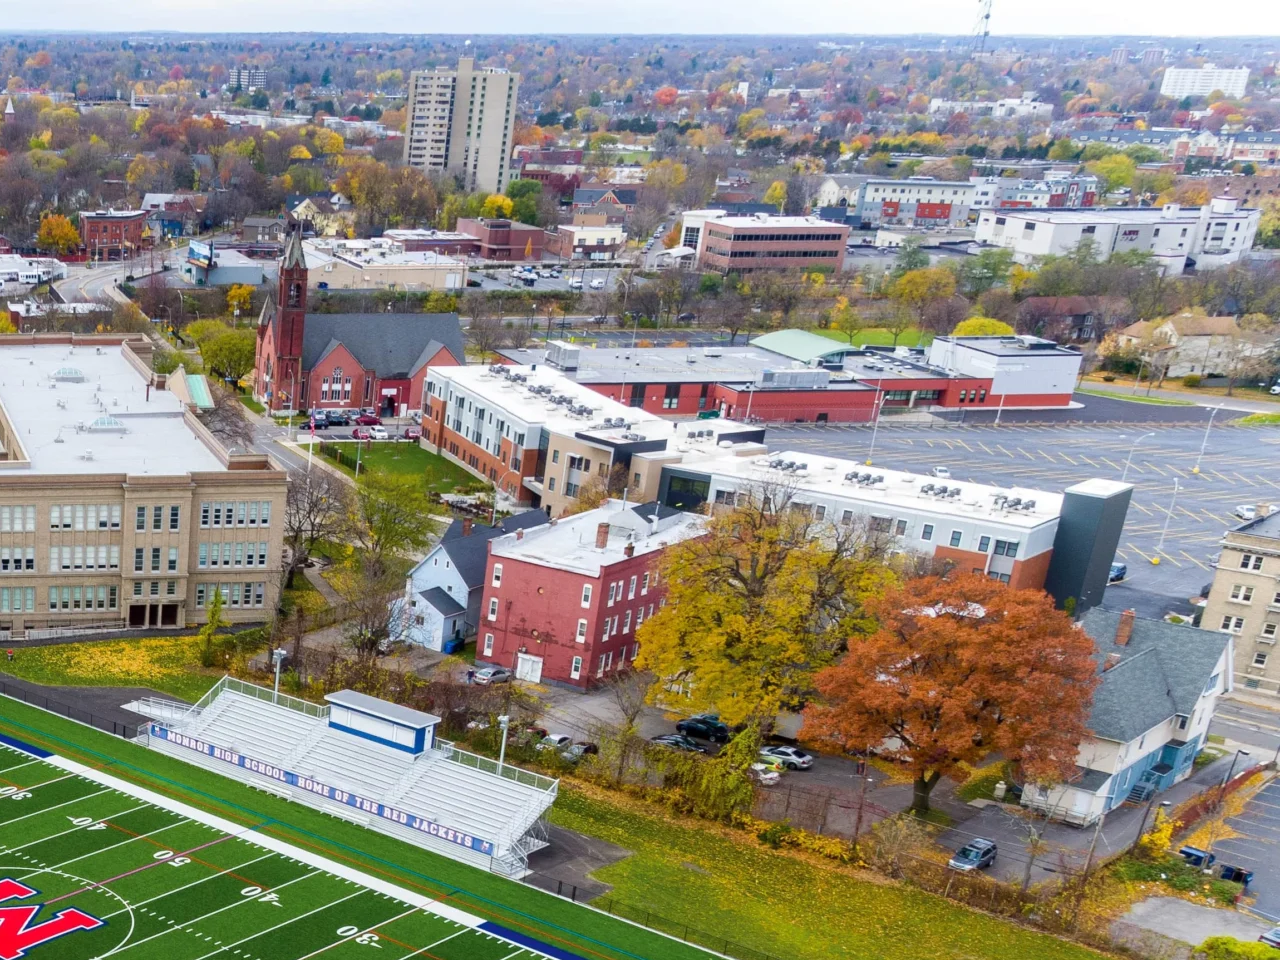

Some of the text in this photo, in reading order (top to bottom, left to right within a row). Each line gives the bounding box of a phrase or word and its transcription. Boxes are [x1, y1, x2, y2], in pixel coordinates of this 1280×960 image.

[167, 730, 473, 847] MONROE HIGH SCHOOL HOME OF THE RED JACKETS
[73, 816, 108, 831] 40
[153, 850, 191, 867] 50
[240, 886, 280, 903] 40
[336, 925, 380, 946] 30
